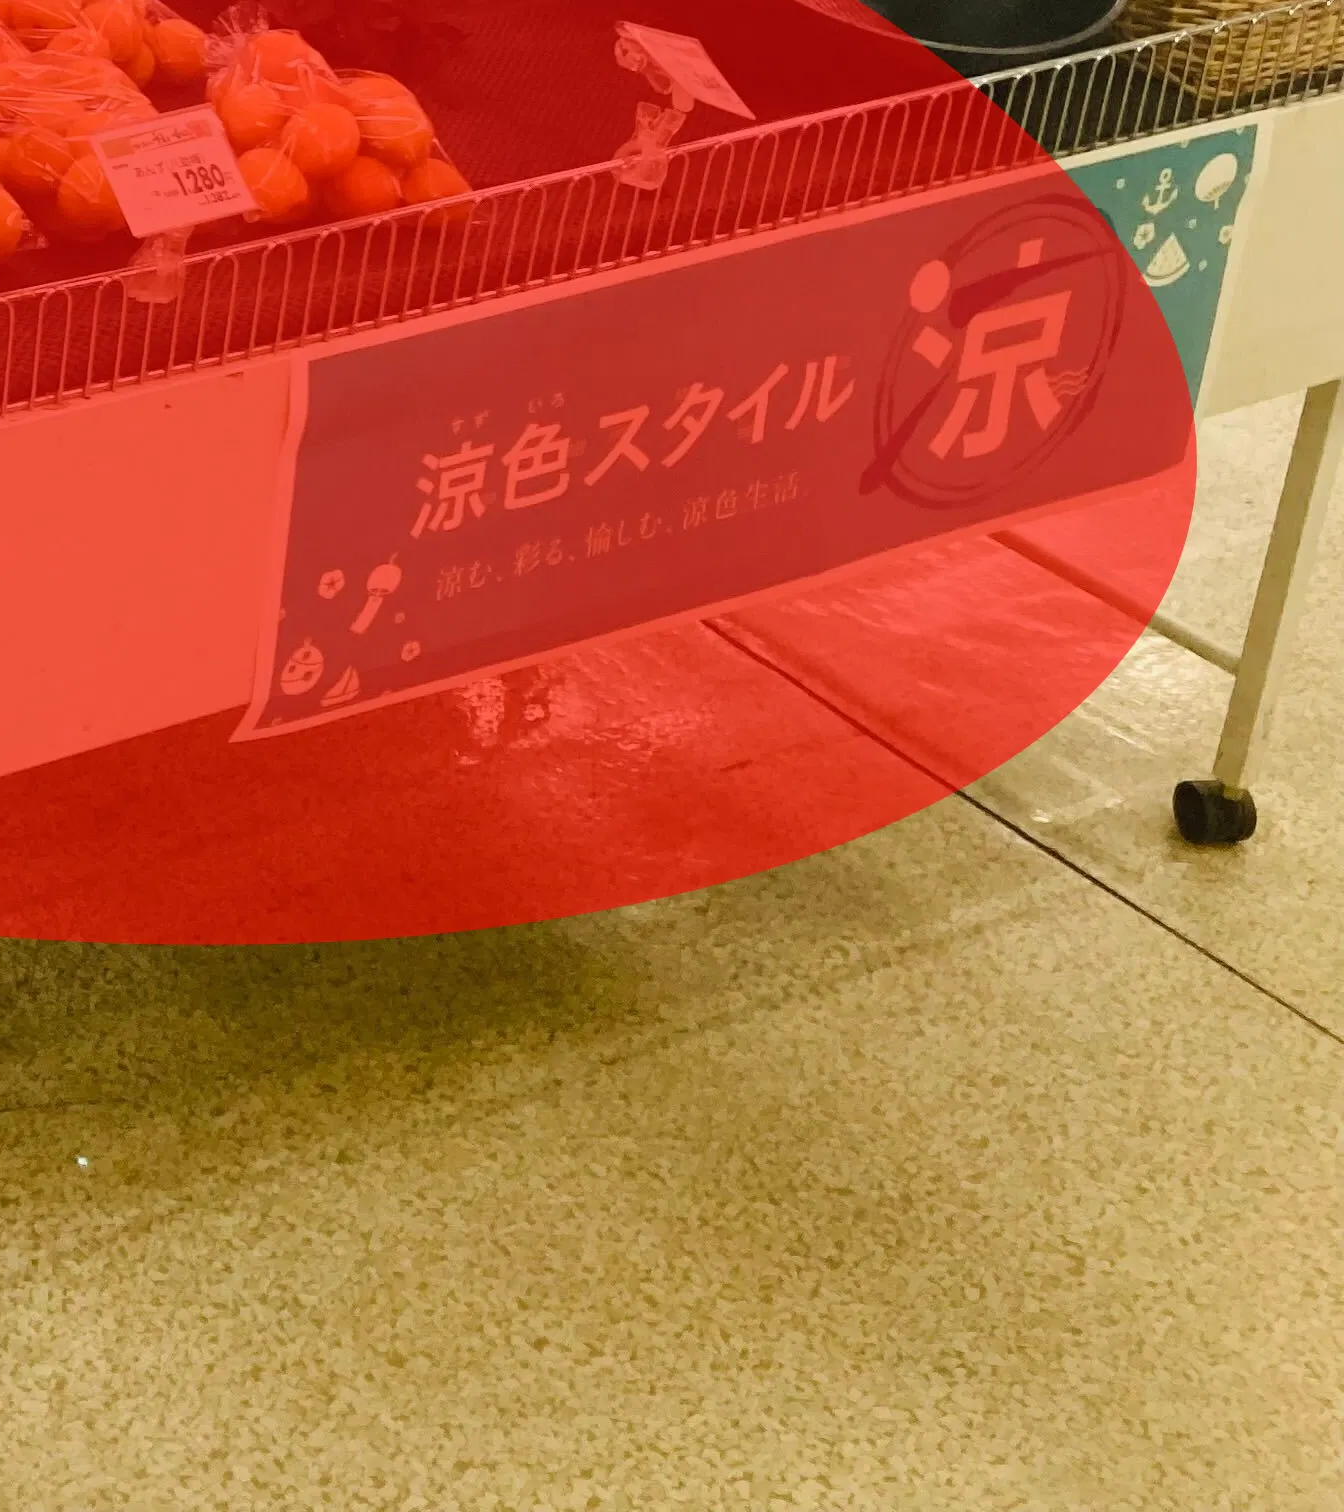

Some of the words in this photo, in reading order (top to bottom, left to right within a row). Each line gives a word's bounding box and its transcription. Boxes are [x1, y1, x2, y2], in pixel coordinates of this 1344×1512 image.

[409, 354, 856, 540] 涼色スタイル
